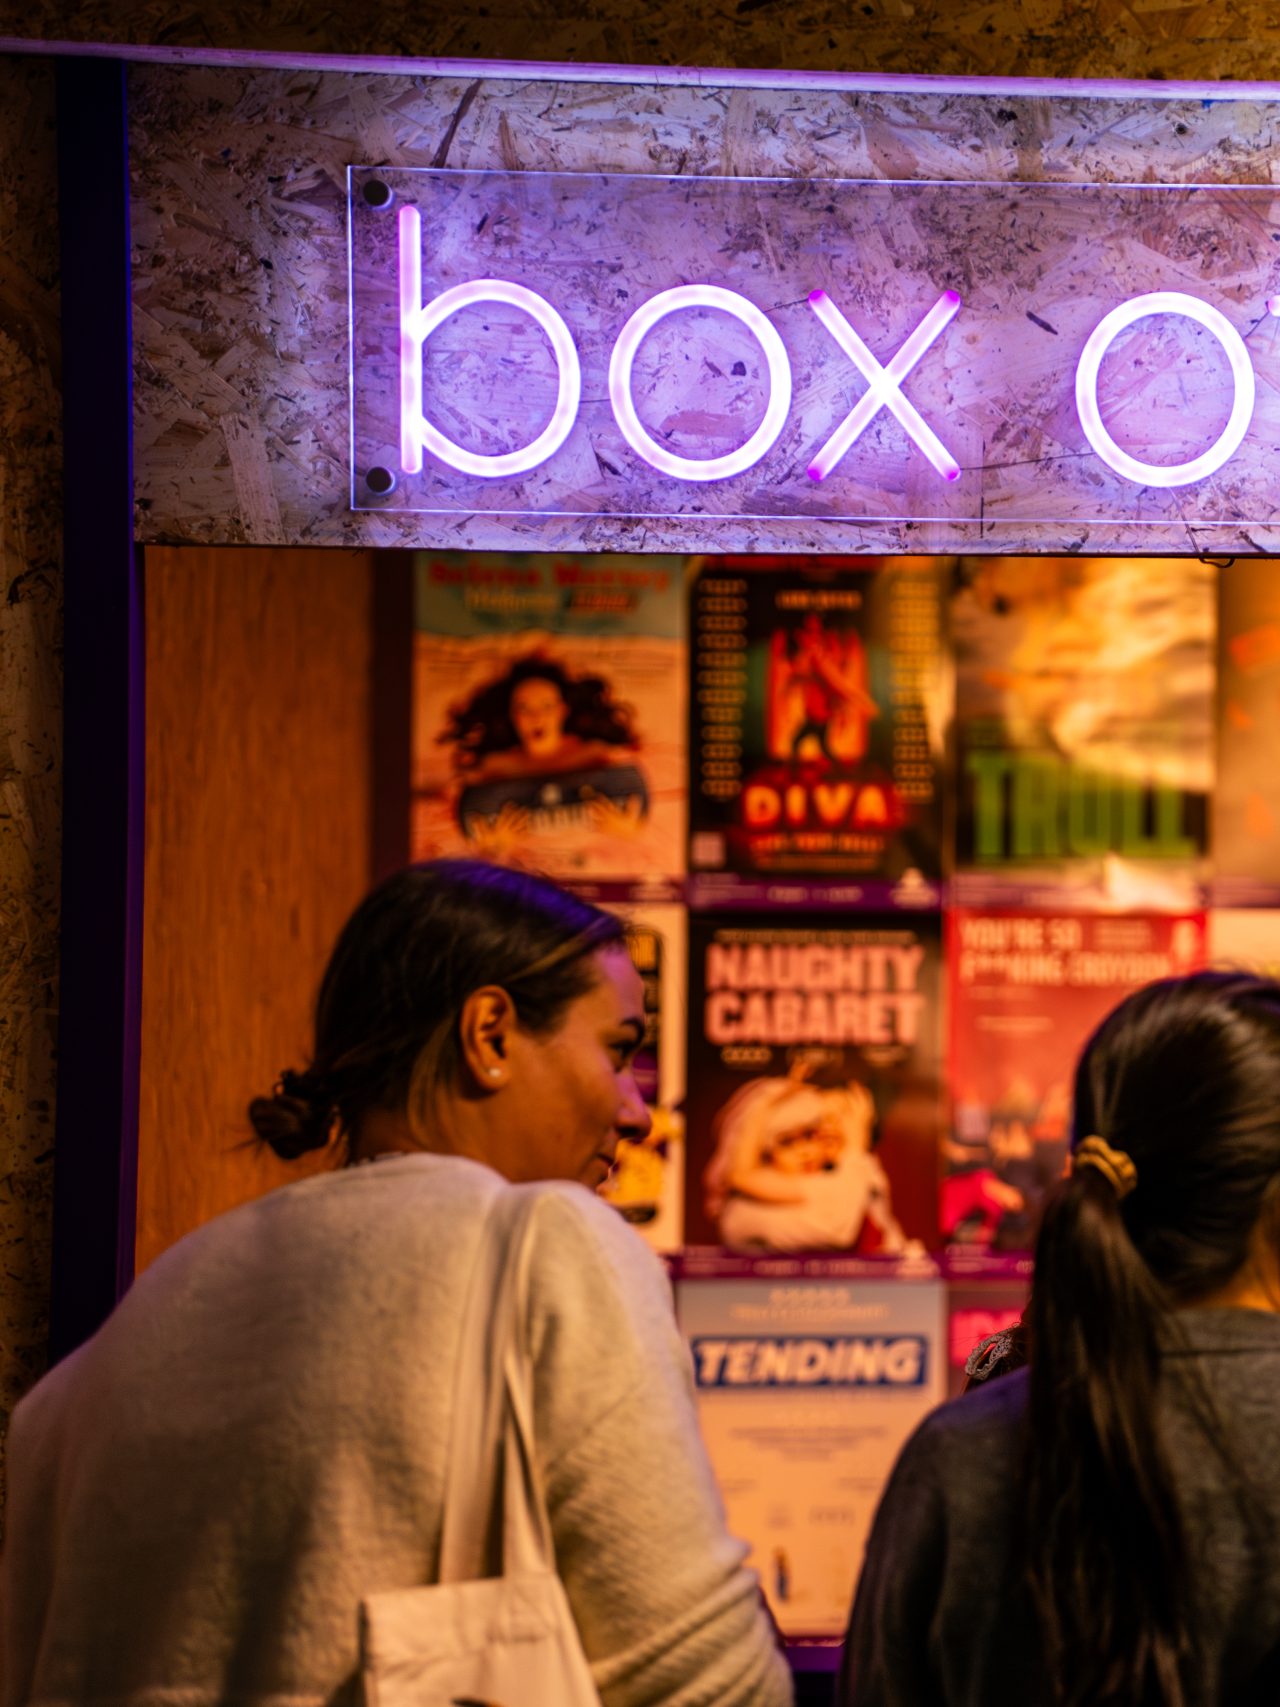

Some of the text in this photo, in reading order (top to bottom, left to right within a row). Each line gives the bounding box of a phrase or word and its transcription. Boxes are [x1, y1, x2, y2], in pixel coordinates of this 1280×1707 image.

[398, 204, 960, 485] box
[744, 785, 888, 826] DIVA
[706, 943, 924, 991] NAUGHTY
[705, 991, 924, 1045] CABARET
[695, 1339, 920, 1382] TENDING
